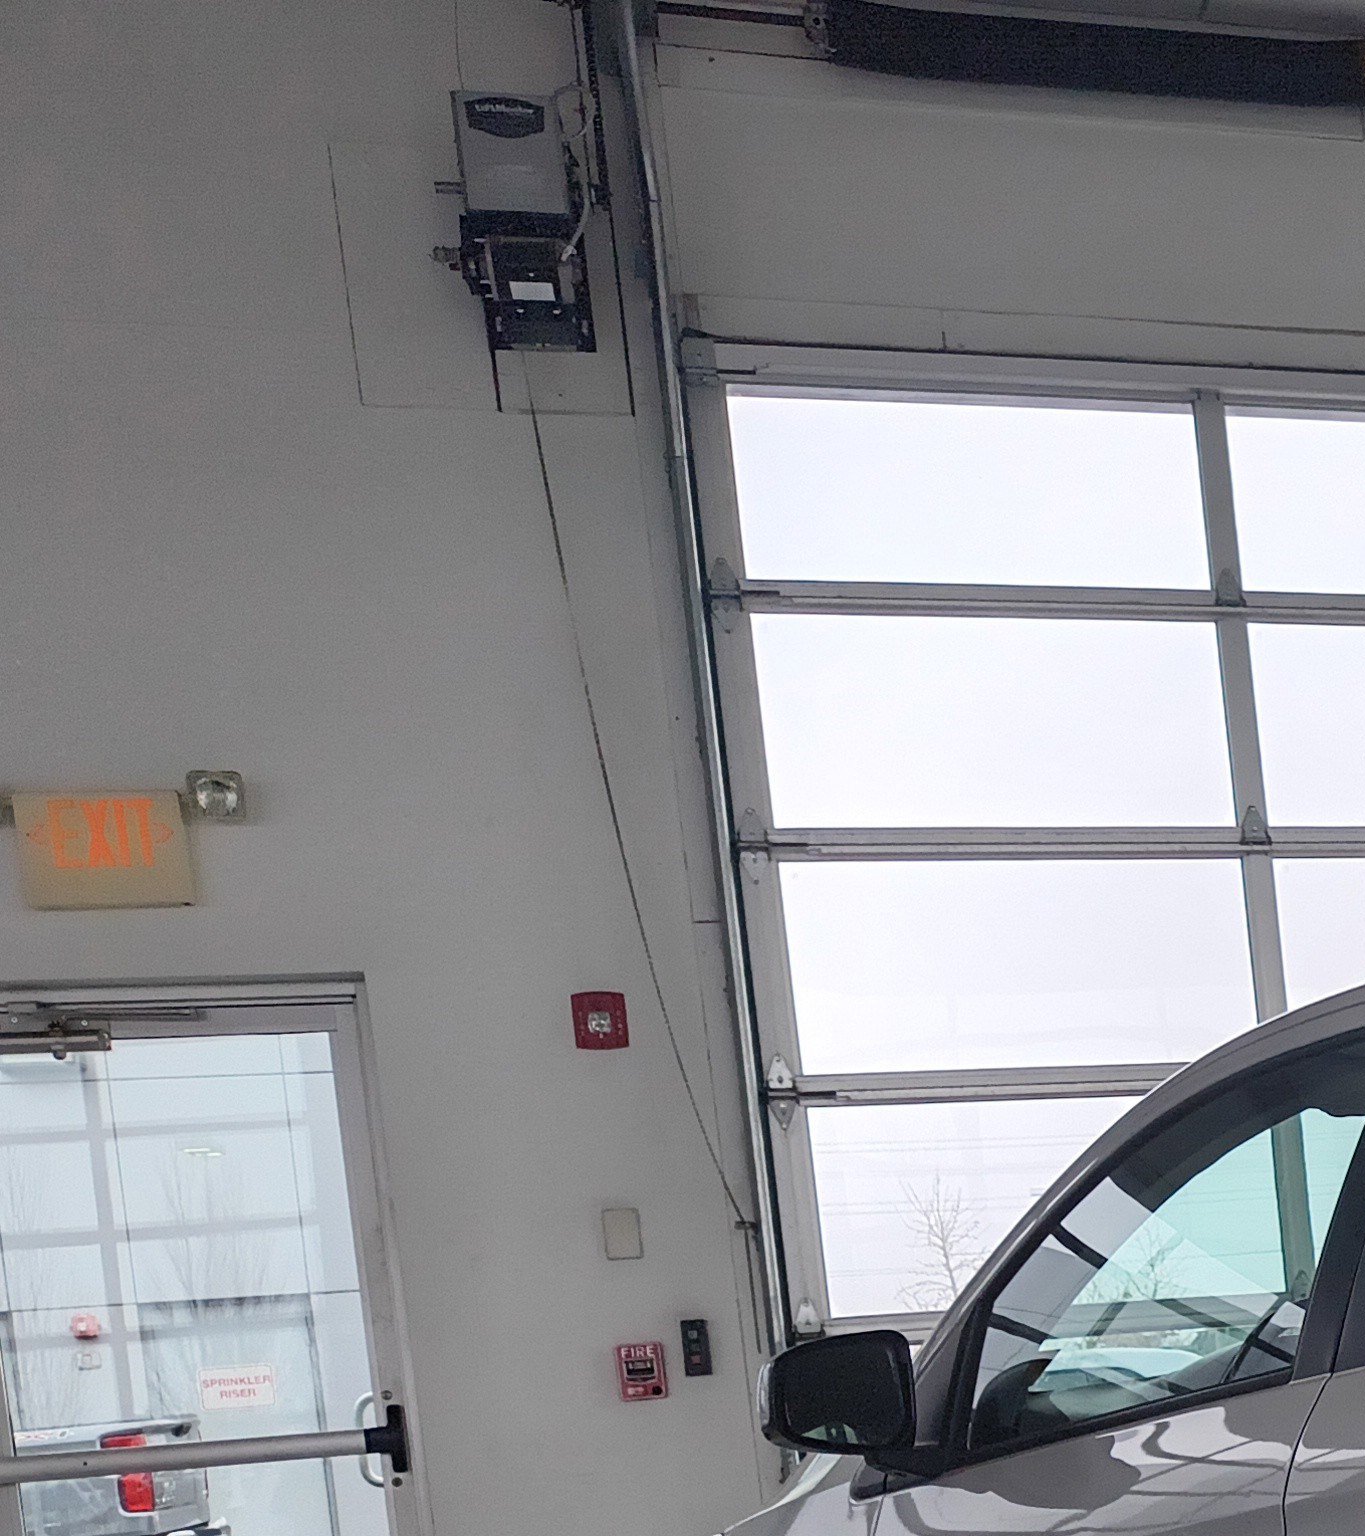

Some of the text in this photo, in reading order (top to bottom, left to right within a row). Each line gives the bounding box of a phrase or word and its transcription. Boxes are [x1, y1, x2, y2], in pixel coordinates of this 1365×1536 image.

[47, 797, 155, 869] EXIT
[621, 1345, 655, 1359] FIRE
[202, 1374, 272, 1389] SPRINKLER
